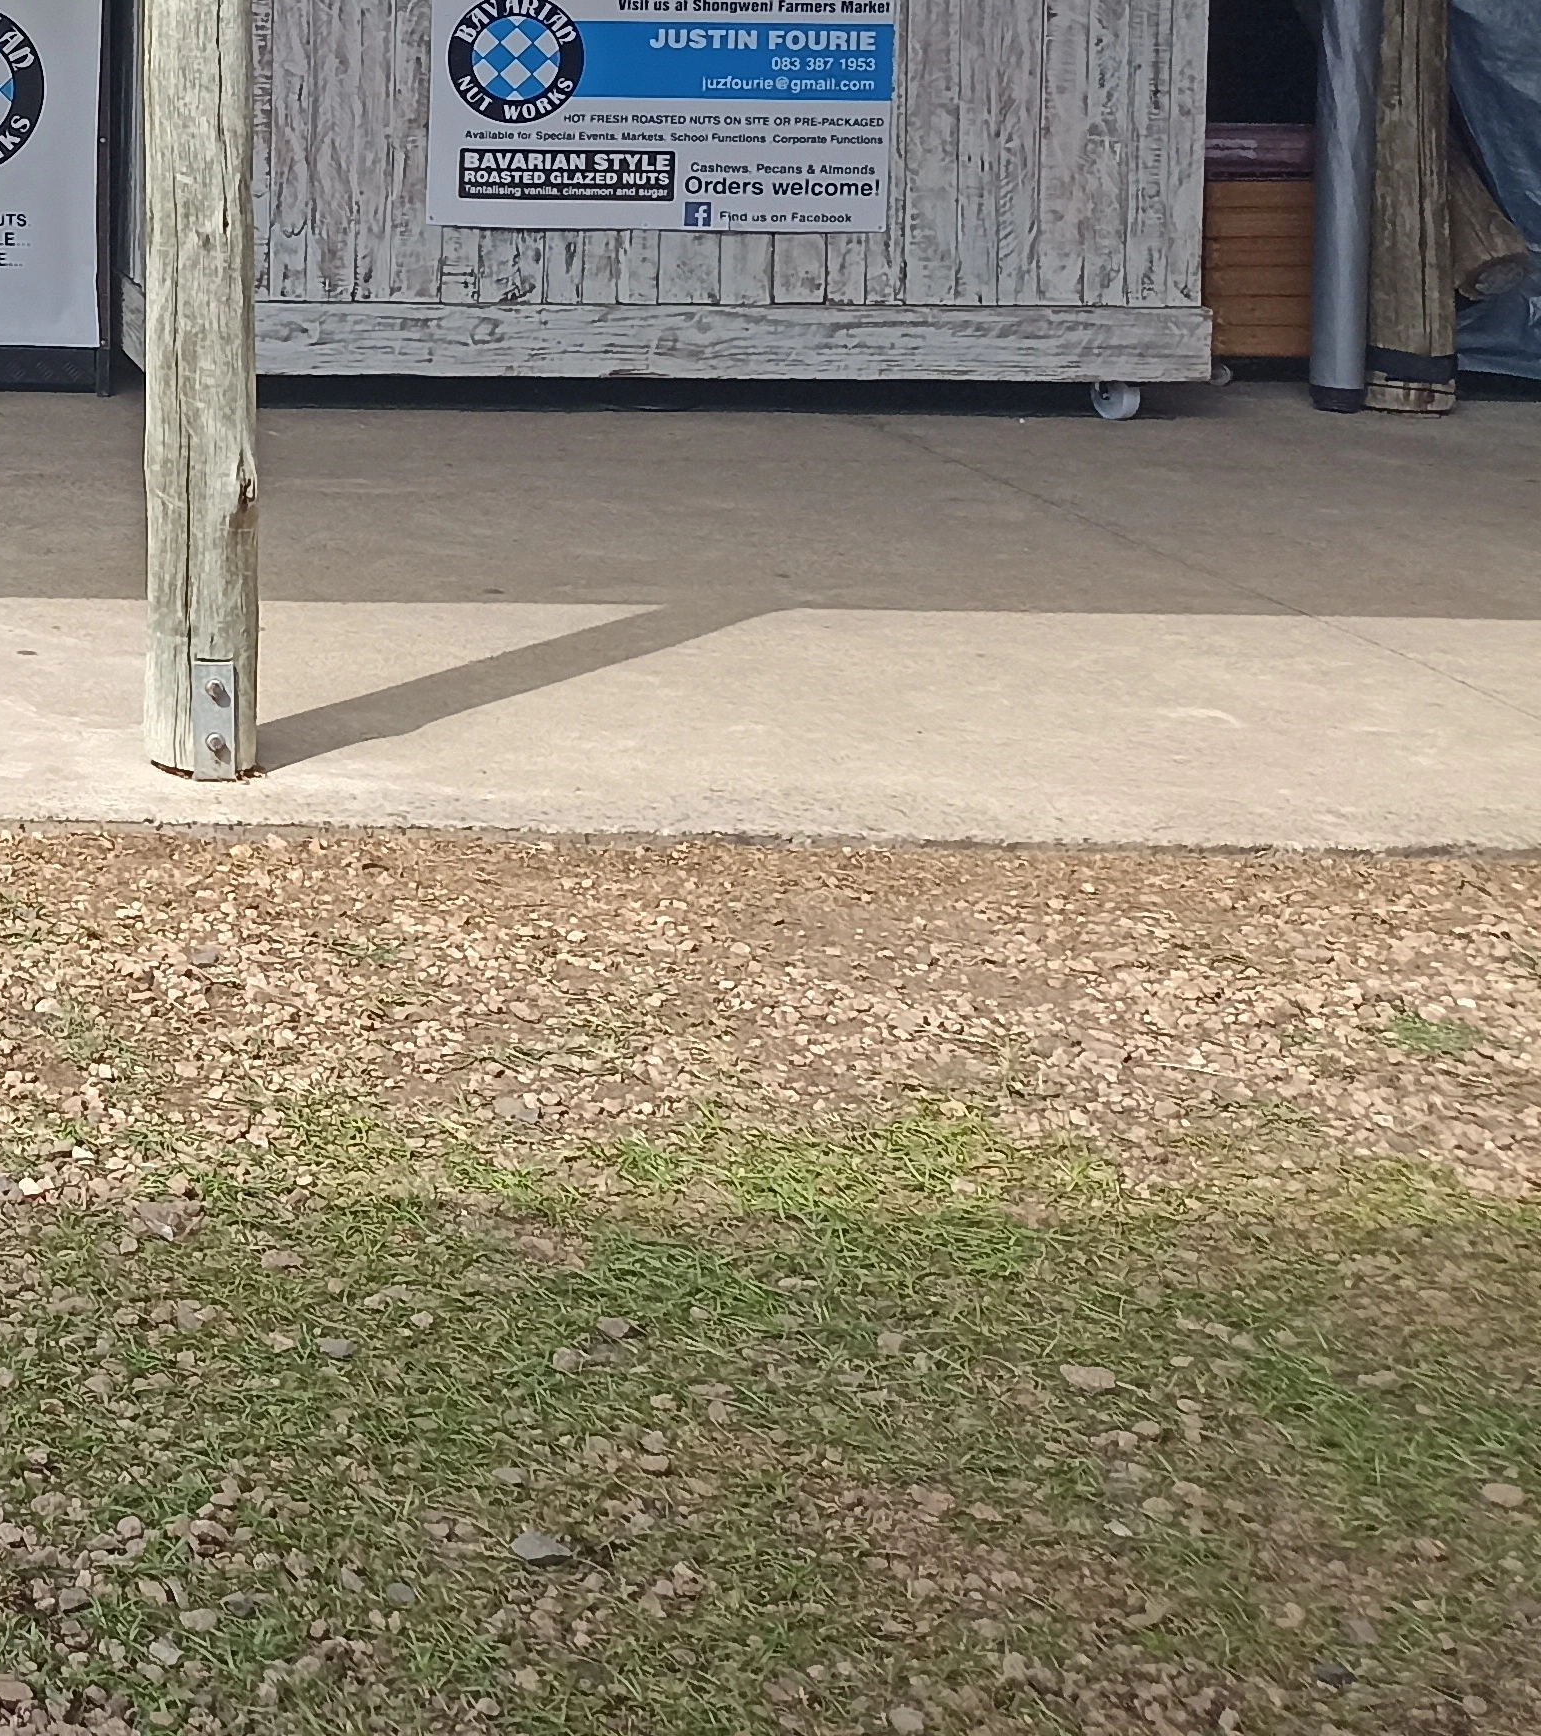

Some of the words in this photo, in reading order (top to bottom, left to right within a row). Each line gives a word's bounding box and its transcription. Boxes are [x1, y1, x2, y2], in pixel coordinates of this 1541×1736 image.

[654, 1, 669, 11] us
[674, 0, 688, 11] at
[693, 0, 773, 14] Shongweni
[778, 0, 836, 13] Farmers
[841, 0, 890, 13] Market
[649, 29, 757, 49] JUSTIN
[768, 31, 876, 50] FOURIE
[771, 57, 801, 70] 083
[806, 57, 833, 70] 387
[839, 58, 876, 70] 1953
[702, 76, 874, 94] juzfourie@gmail.com
[457, 75, 492, 111] NUT
[503, 78, 573, 120] WORKS
[564, 115, 586, 123] HOT
[590, 115, 628, 124] FRESH
[631, 115, 686, 125] ROASTED
[689, 116, 721, 125] NUTS
[724, 116, 741, 125] ON
[745, 116, 770, 125] SITE
[773, 117, 791, 126] OR
[794, 118, 885, 127] PRE-PACKAGED
[465, 130, 514, 140] Available
[517, 131, 531, 140] for
[535, 131, 575, 141] Special
[670, 133, 708, 142] School
[712, 133, 766, 143] Functions
[830, 134, 883, 144] Functions
[464, 152, 586, 169] BAVARIAN
[594, 154, 671, 170] STYLE
[756, 164, 802, 174] Pecans
[806, 164, 815, 174] &
[820, 165, 875, 175] Almonds
[464, 171, 545, 183] ROASTED
[550, 172, 617, 184] GLAZED
[622, 173, 669, 185] NUTS
[465, 185, 521, 196] Tantalising
[563, 187, 614, 196] cinnamon
[616, 187, 635, 196] and
[638, 189, 668, 199] sugar
[684, 176, 764, 195] Orders
[772, 179, 880, 196] welcome!
[720, 211, 748, 222] Find
[752, 214, 767, 222] us
[771, 214, 787, 222] on
[791, 212, 852, 223] Facebook
